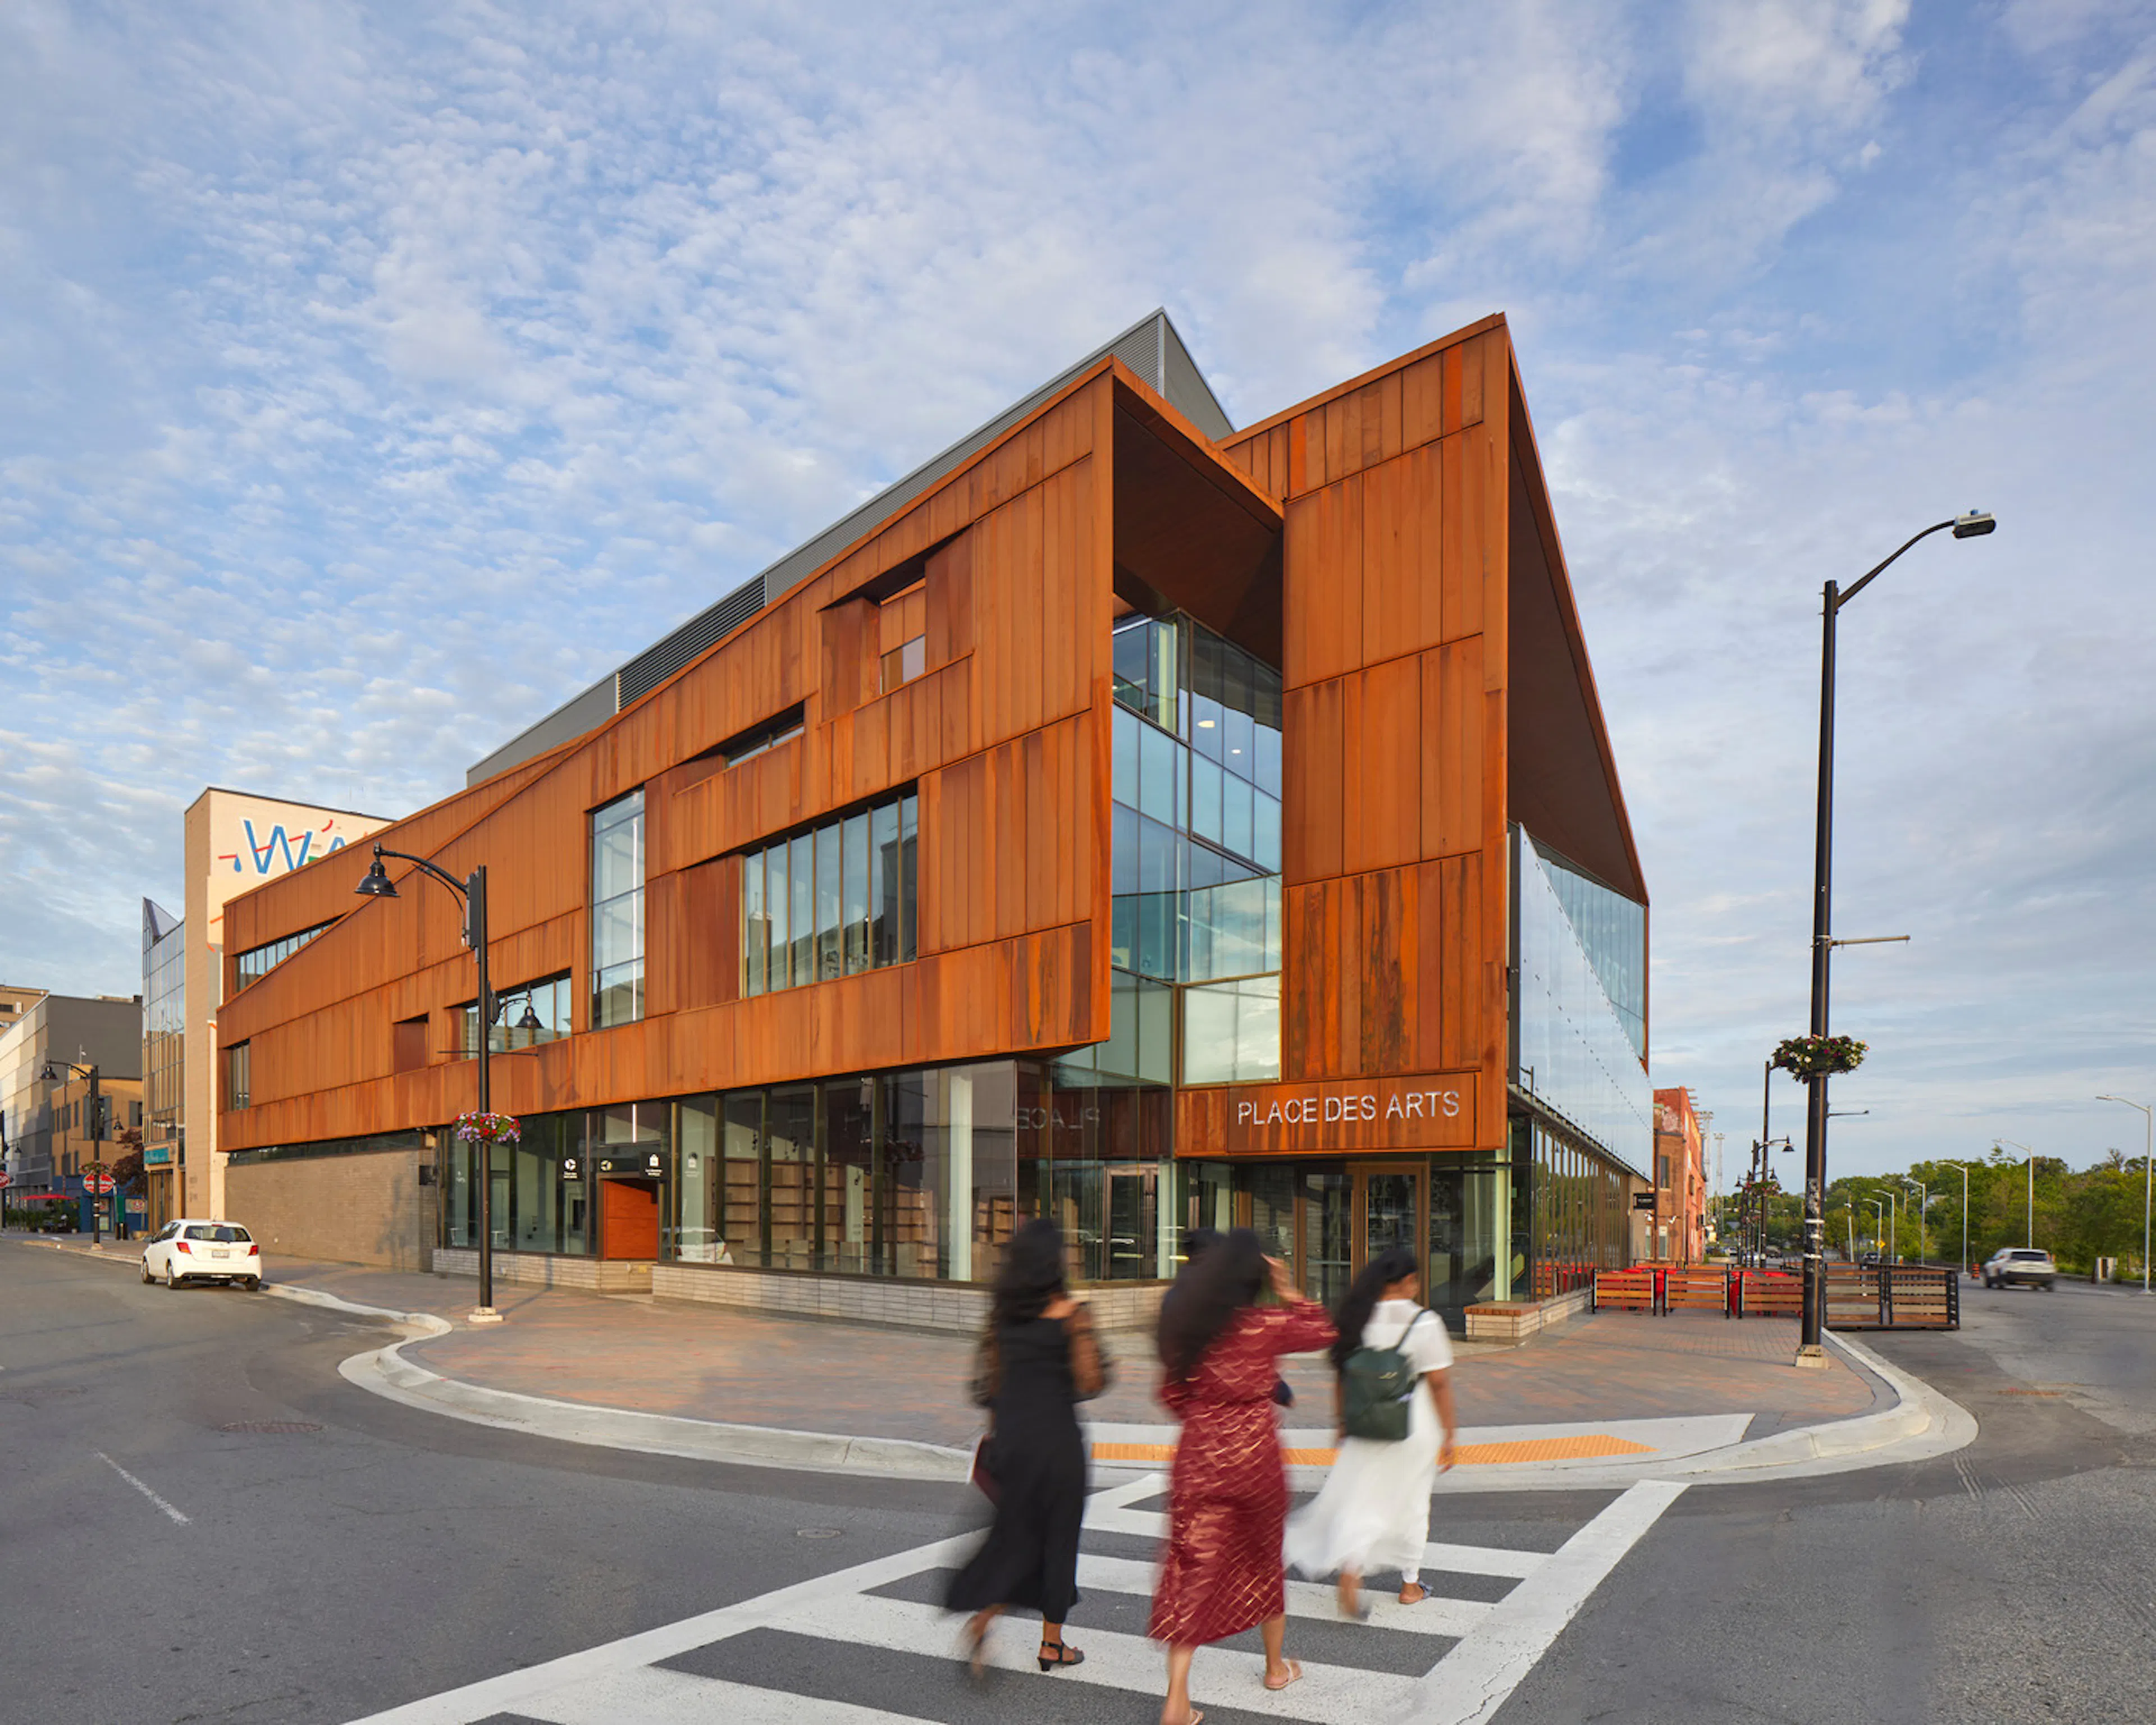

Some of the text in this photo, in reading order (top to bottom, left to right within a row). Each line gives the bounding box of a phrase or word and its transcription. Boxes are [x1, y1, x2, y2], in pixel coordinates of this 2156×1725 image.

[1237, 1091, 1460, 1125] PLACE DES ARTS
